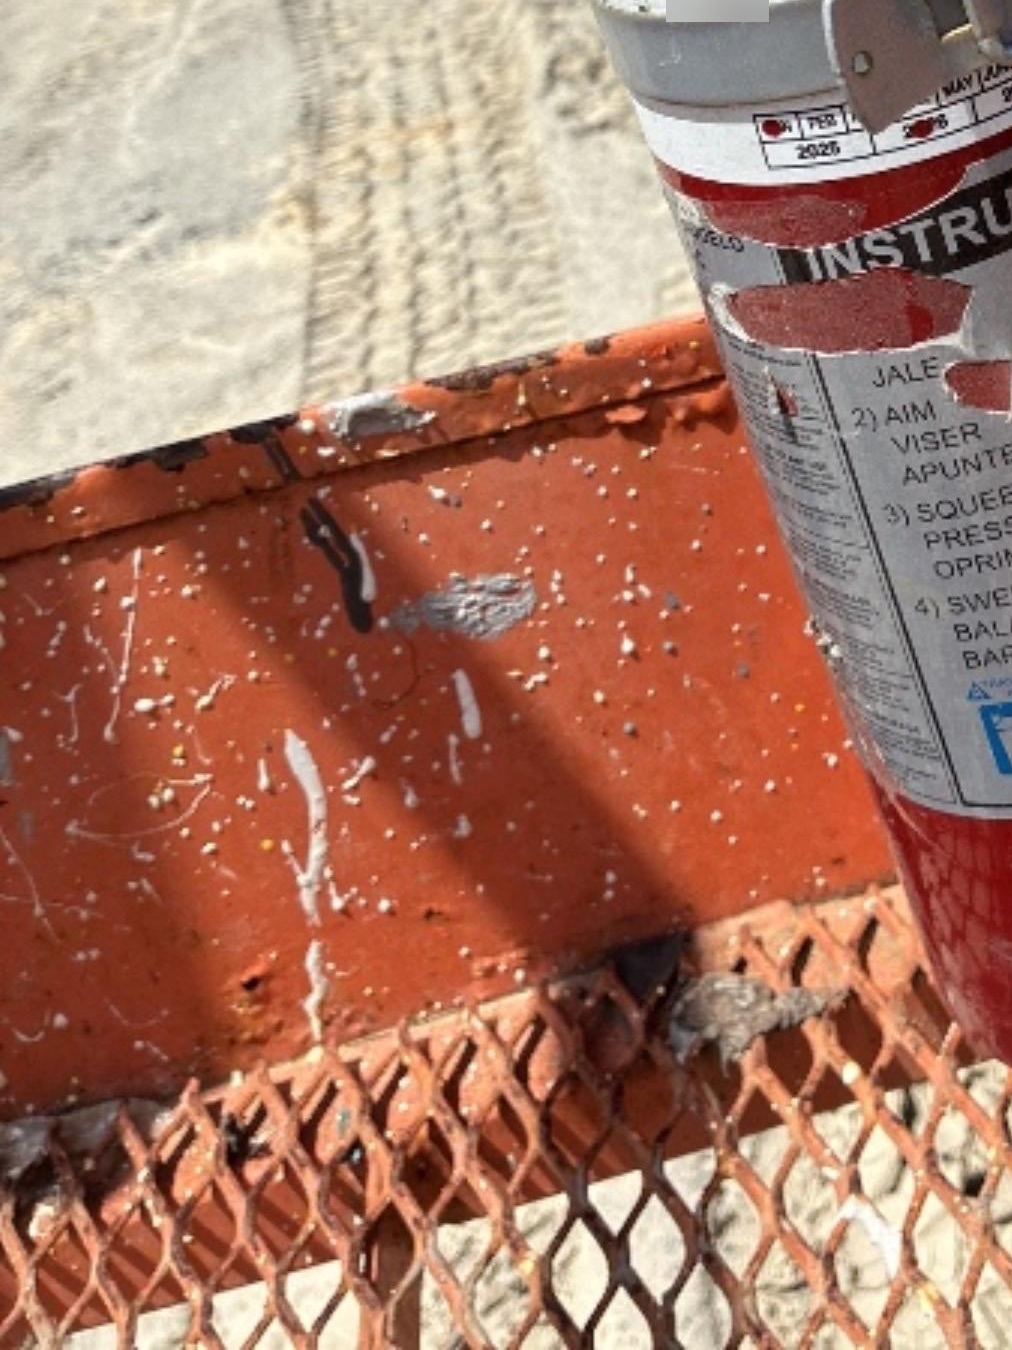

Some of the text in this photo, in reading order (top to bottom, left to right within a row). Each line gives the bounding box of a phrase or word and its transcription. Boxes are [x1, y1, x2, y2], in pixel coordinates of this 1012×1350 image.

[902, 113, 949, 139] 26
[872, 356, 941, 388] JALE
[851, 400, 937, 433] 2) AIM
[890, 422, 983, 454] VISER
[882, 503, 911, 527] 3)
[914, 598, 941, 619] 4)
